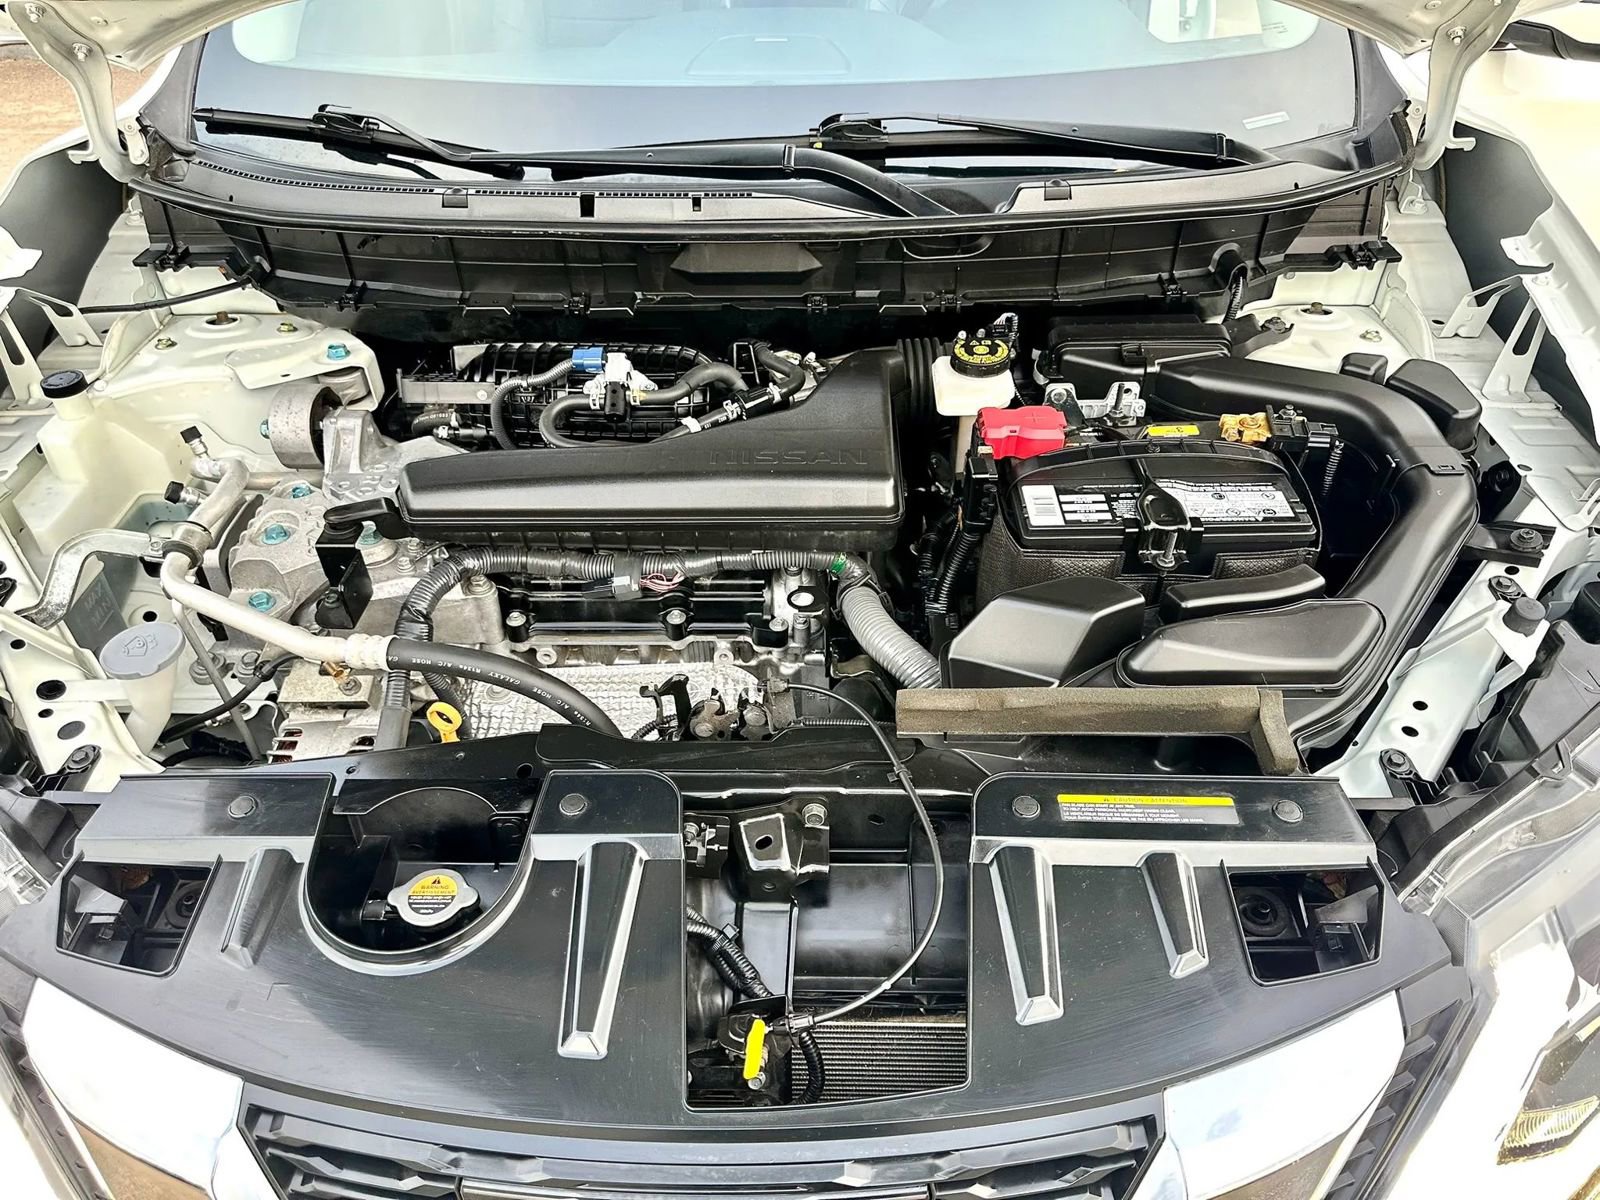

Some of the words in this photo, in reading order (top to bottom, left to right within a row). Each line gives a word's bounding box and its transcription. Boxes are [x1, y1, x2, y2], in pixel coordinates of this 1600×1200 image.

[709, 451, 868, 465] NISSAN
[411, 657, 432, 665] HOSE
[487, 671, 521, 686] GALAXY
[532, 686, 553, 700] HOSE
